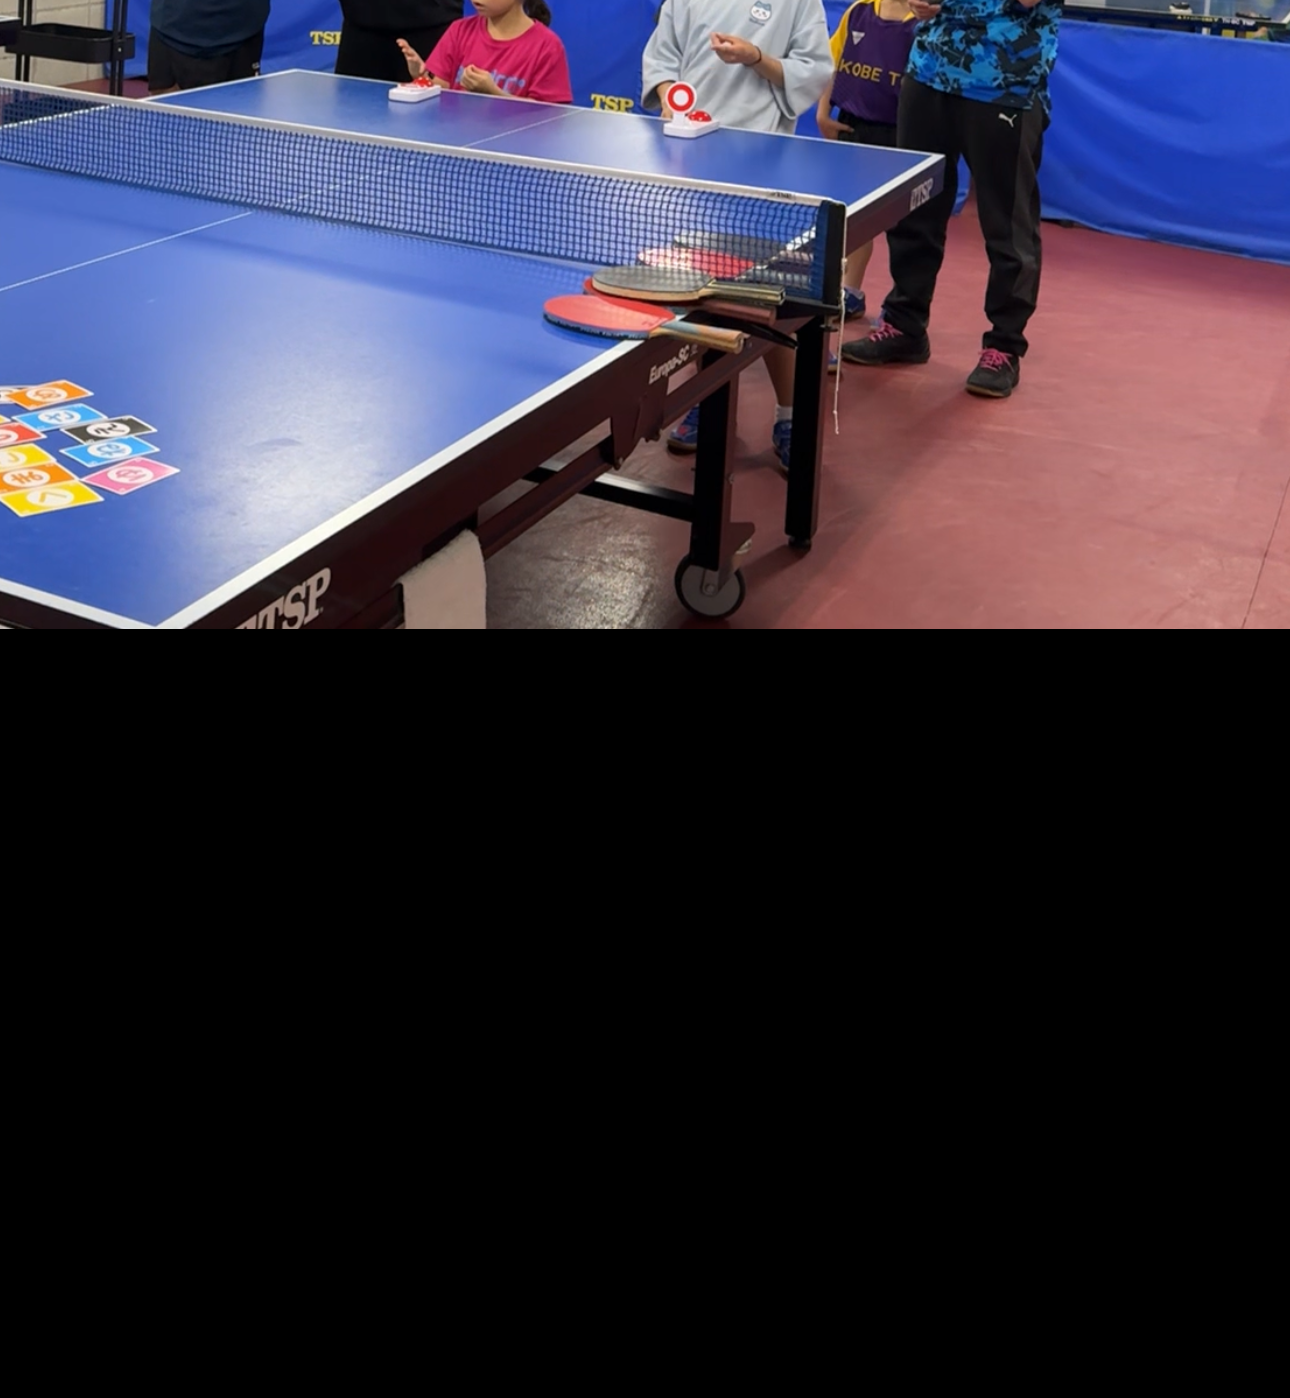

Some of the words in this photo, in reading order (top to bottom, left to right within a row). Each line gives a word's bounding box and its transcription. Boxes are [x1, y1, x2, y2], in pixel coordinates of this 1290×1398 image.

[839, 59, 883, 82] KOBE
[591, 93, 634, 112] TSP
[257, 567, 331, 629] TSP
